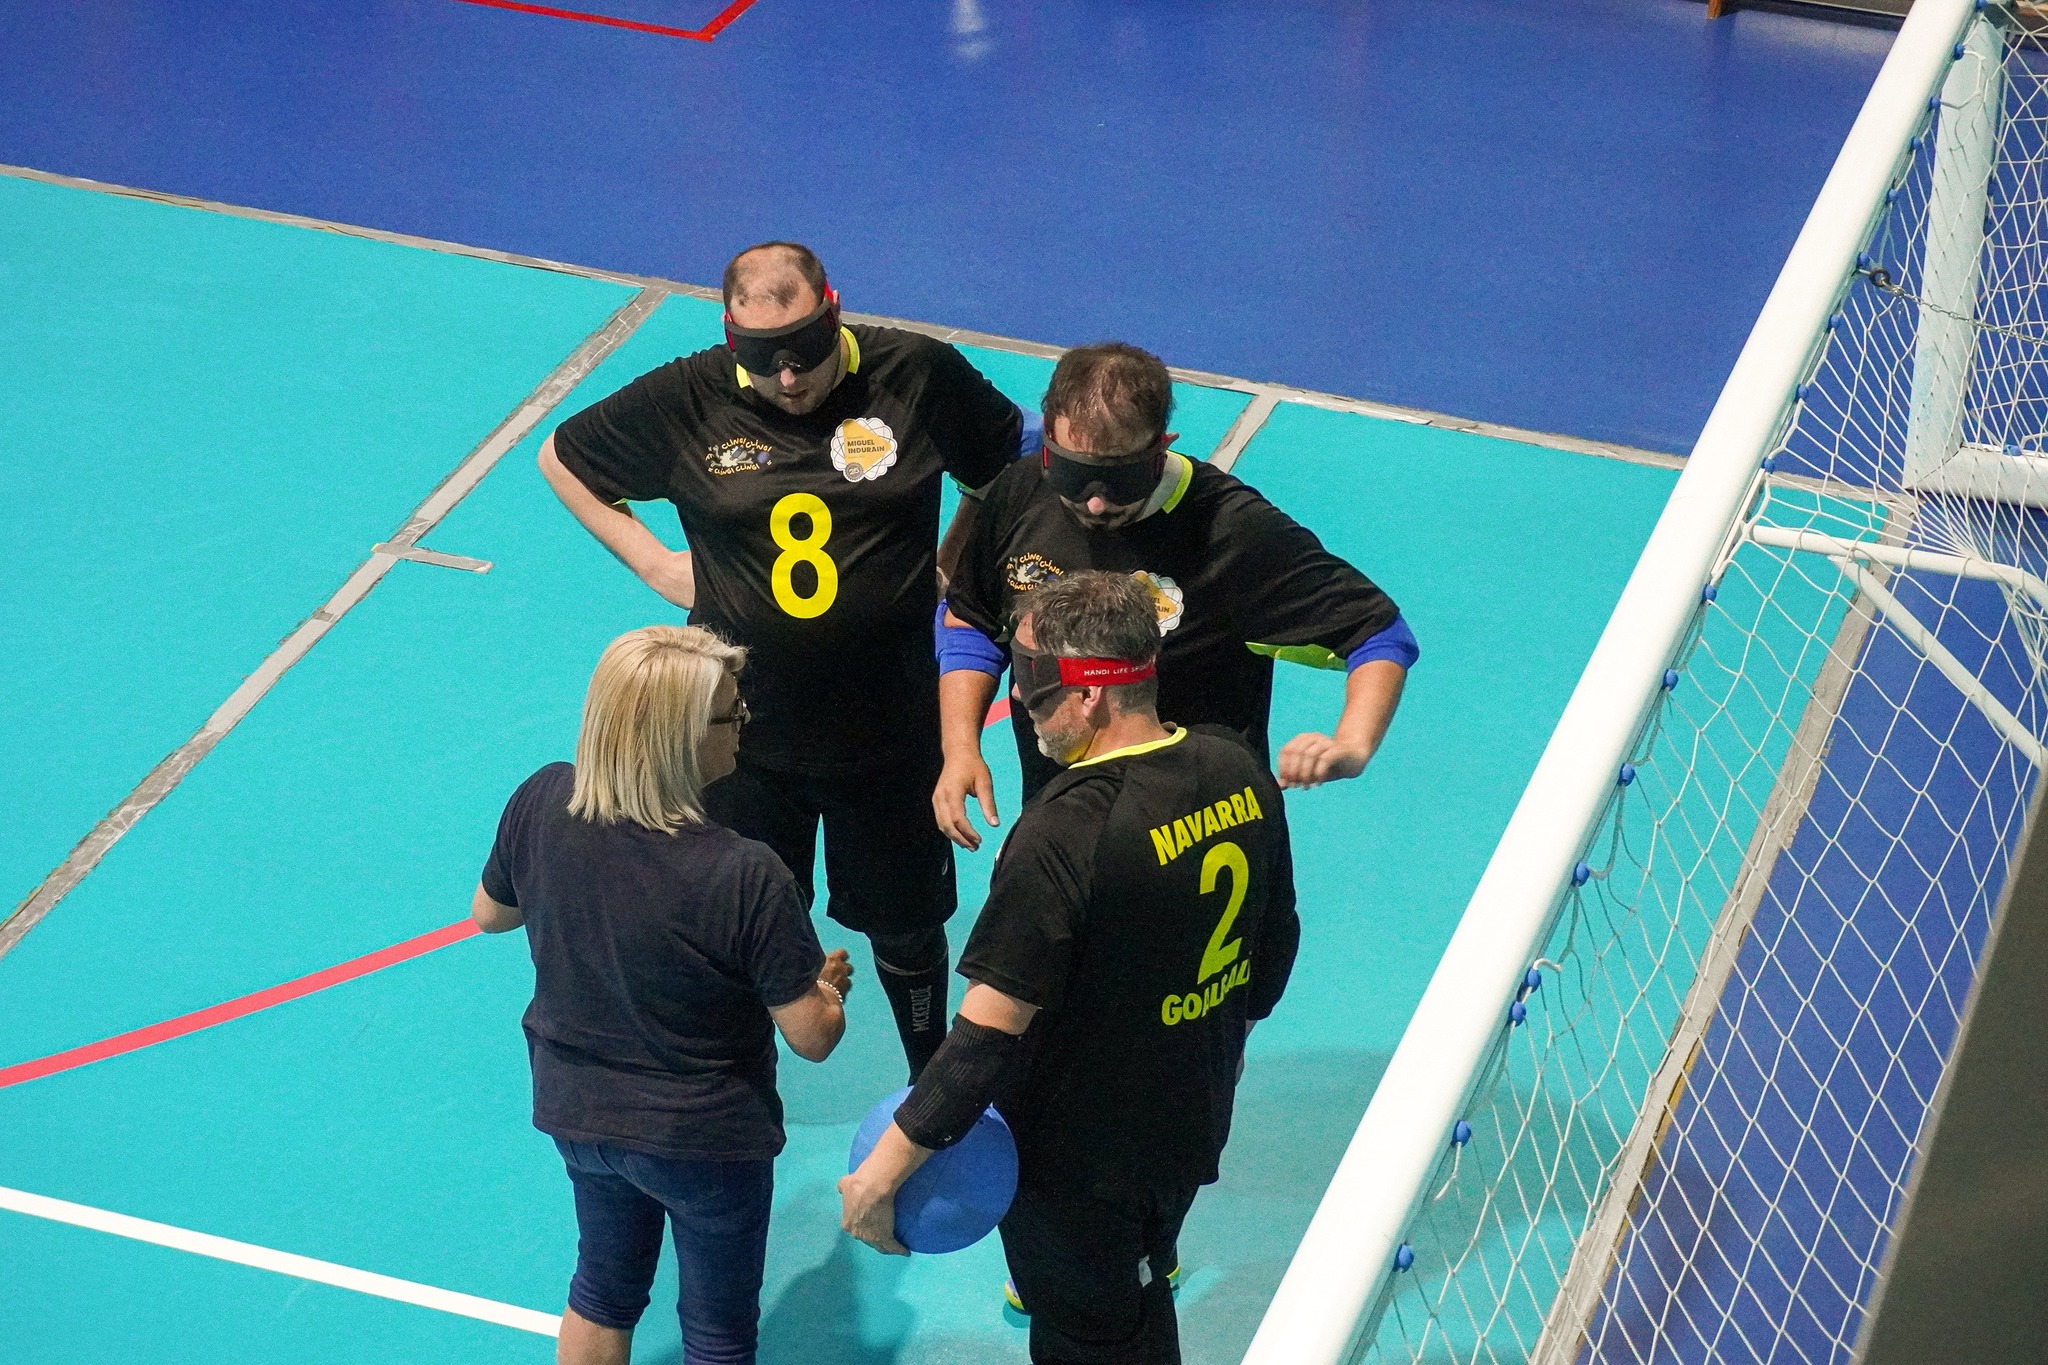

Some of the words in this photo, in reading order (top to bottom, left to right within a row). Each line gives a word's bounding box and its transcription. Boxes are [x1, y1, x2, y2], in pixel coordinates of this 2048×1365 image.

[847, 439, 875, 447] MIGUEL
[847, 446, 885, 454] INDURAIN
[769, 492, 839, 619] 8
[1150, 786, 1264, 866] NAVARRA
[1197, 841, 1250, 985] 2
